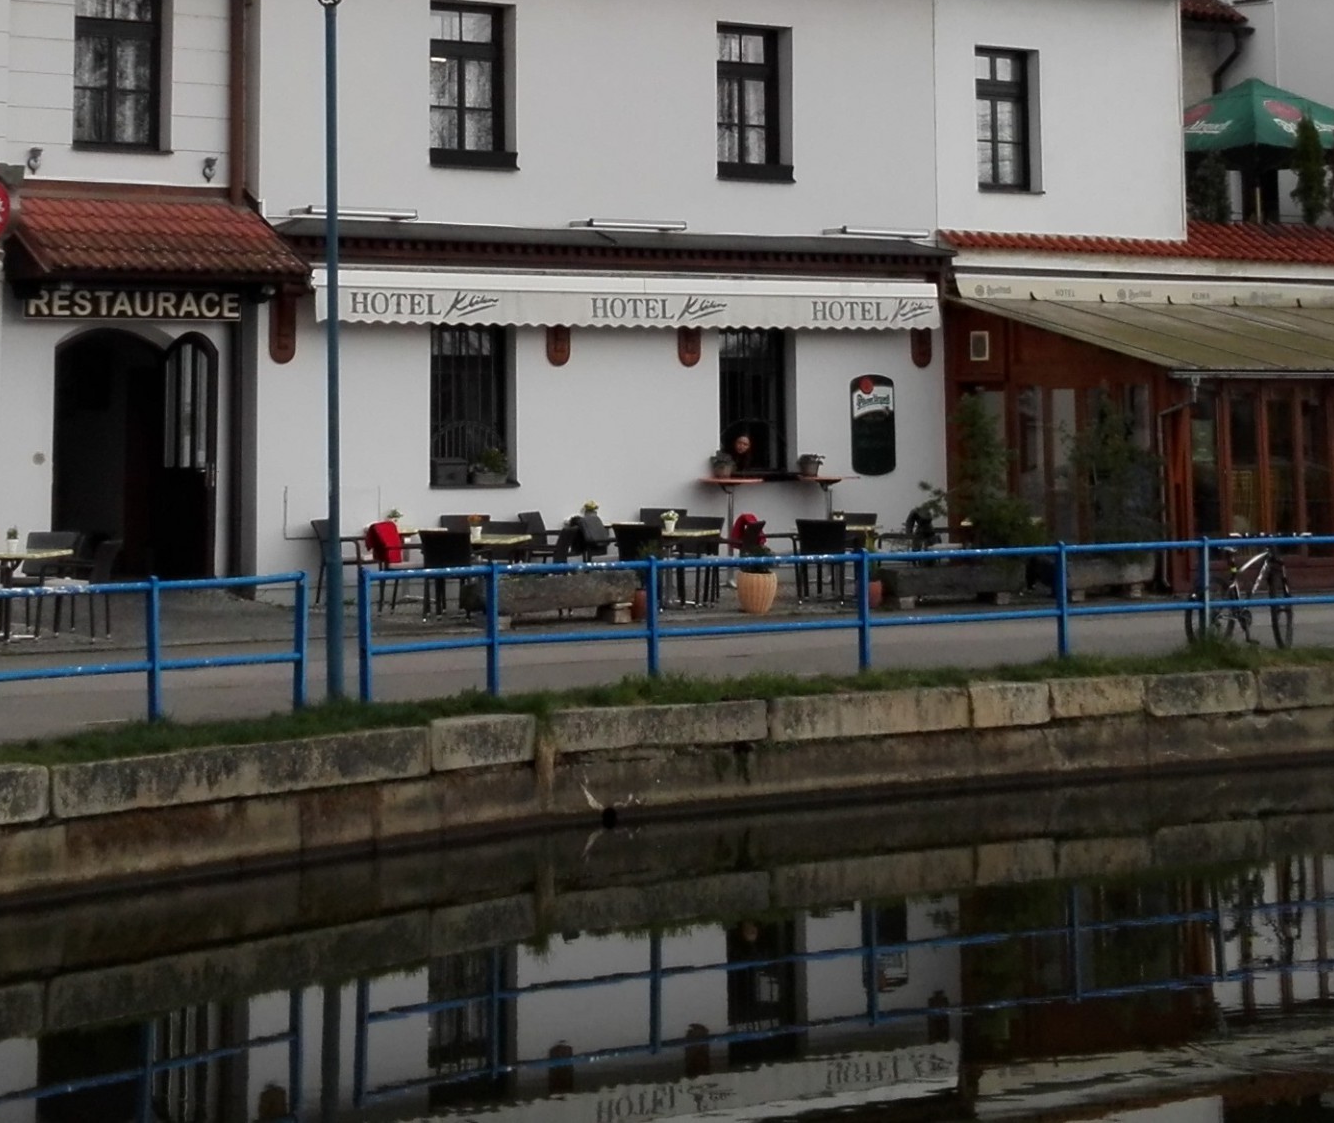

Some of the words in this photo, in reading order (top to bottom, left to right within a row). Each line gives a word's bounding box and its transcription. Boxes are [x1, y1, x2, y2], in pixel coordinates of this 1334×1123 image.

[27, 290, 240, 318] RESTAURACE
[350, 291, 442, 316] HOTEL
[590, 297, 675, 320] HOTEL
[811, 300, 889, 322] HOTEL
